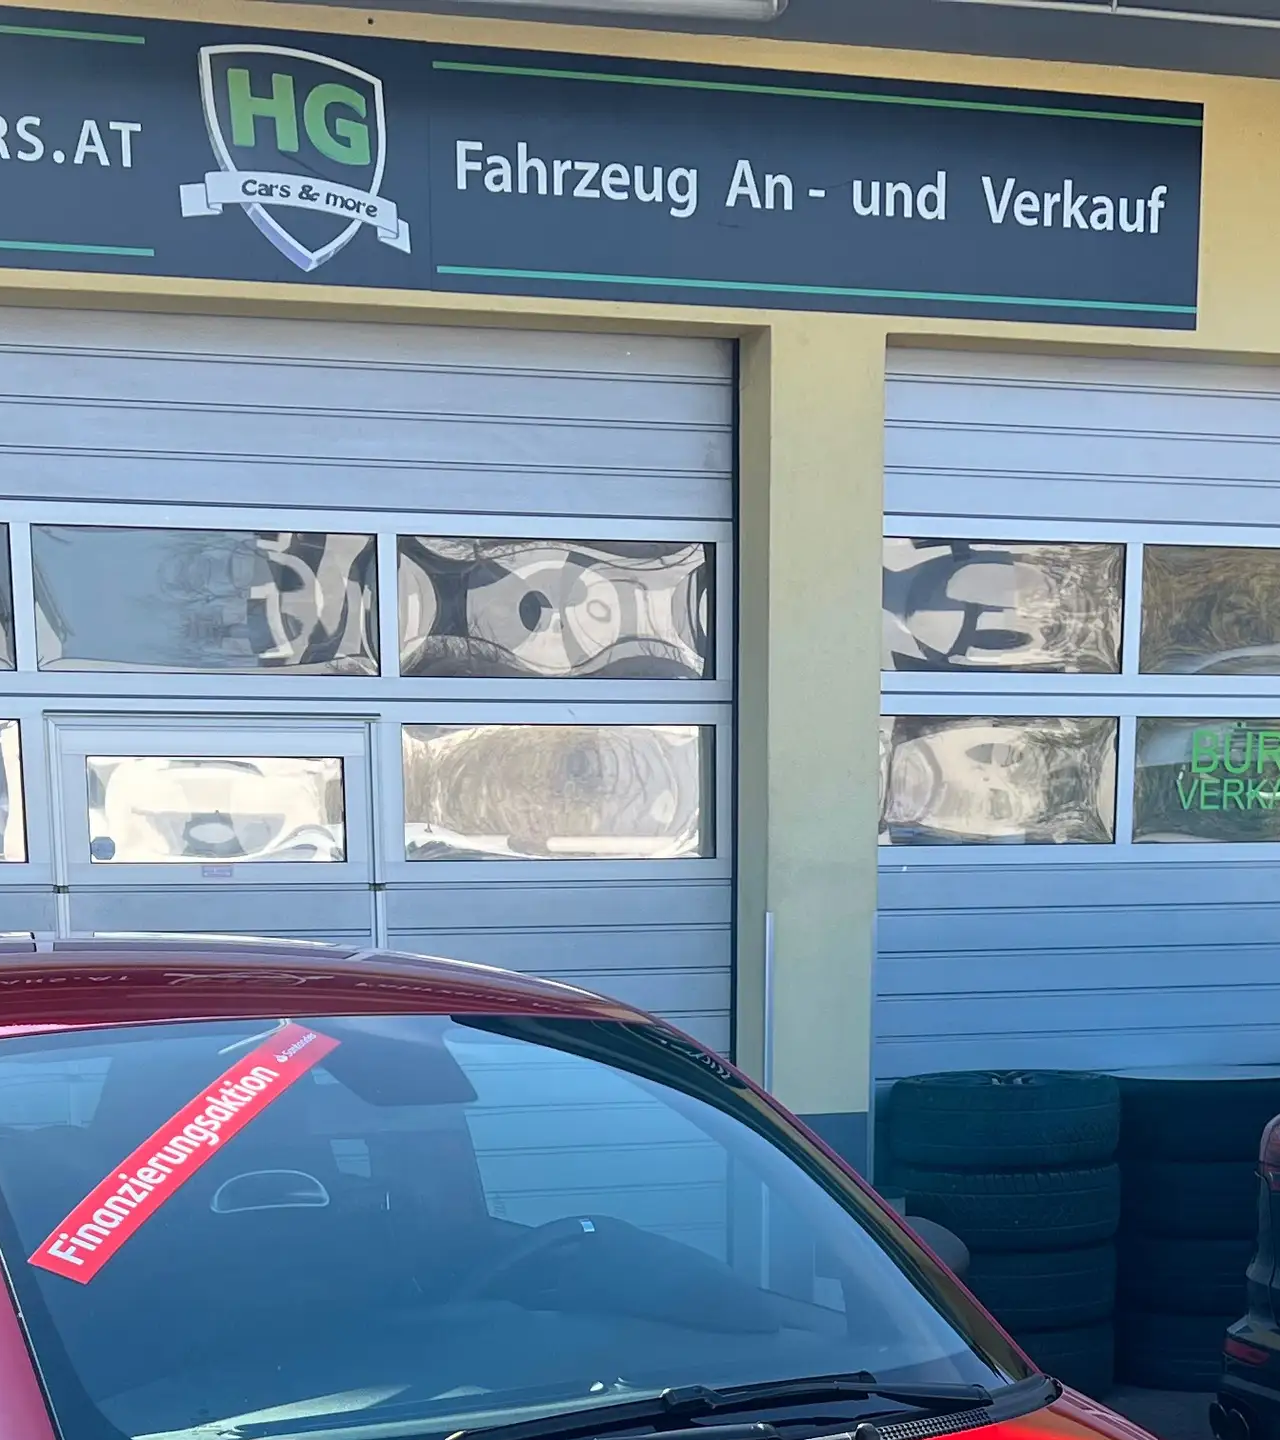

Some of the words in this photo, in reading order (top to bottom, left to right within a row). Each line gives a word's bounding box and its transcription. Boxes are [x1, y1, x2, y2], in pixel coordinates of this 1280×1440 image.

[227, 67, 371, 166] HG
[241, 178, 291, 200] Cars
[298, 184, 320, 202] &
[325, 191, 378, 218] more
[454, 139, 699, 218] Fahrzeug
[852, 171, 947, 221] und
[982, 176, 1168, 234] Verkauf
[47, 1066, 279, 1265] Finanzierungsaktion
